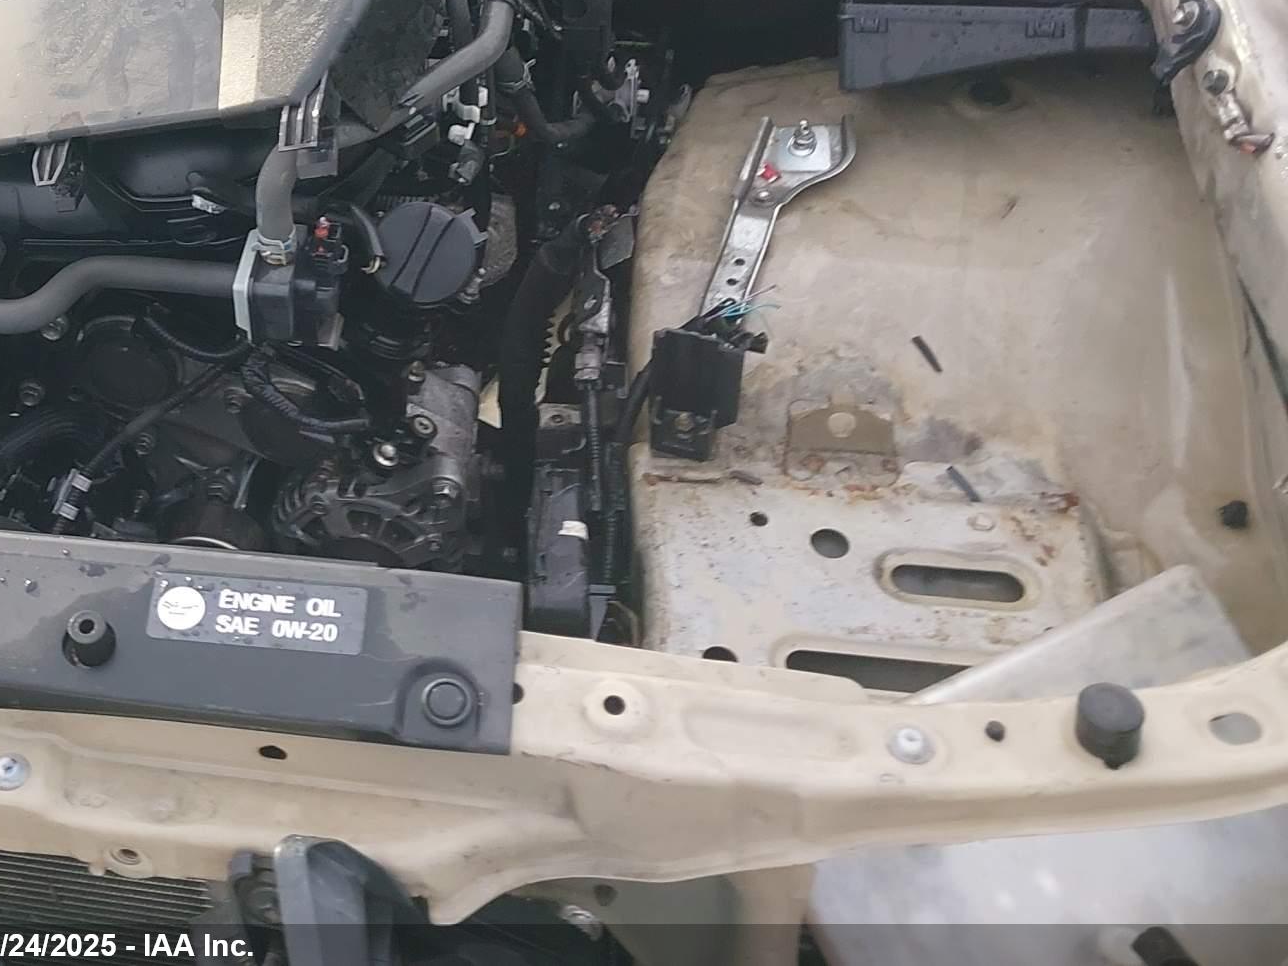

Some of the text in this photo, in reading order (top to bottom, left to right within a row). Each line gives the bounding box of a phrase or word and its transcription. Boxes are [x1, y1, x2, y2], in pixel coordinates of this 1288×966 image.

[218, 589, 342, 618] ENGINE OIL
[215, 614, 339, 643] SAE 0W-20
